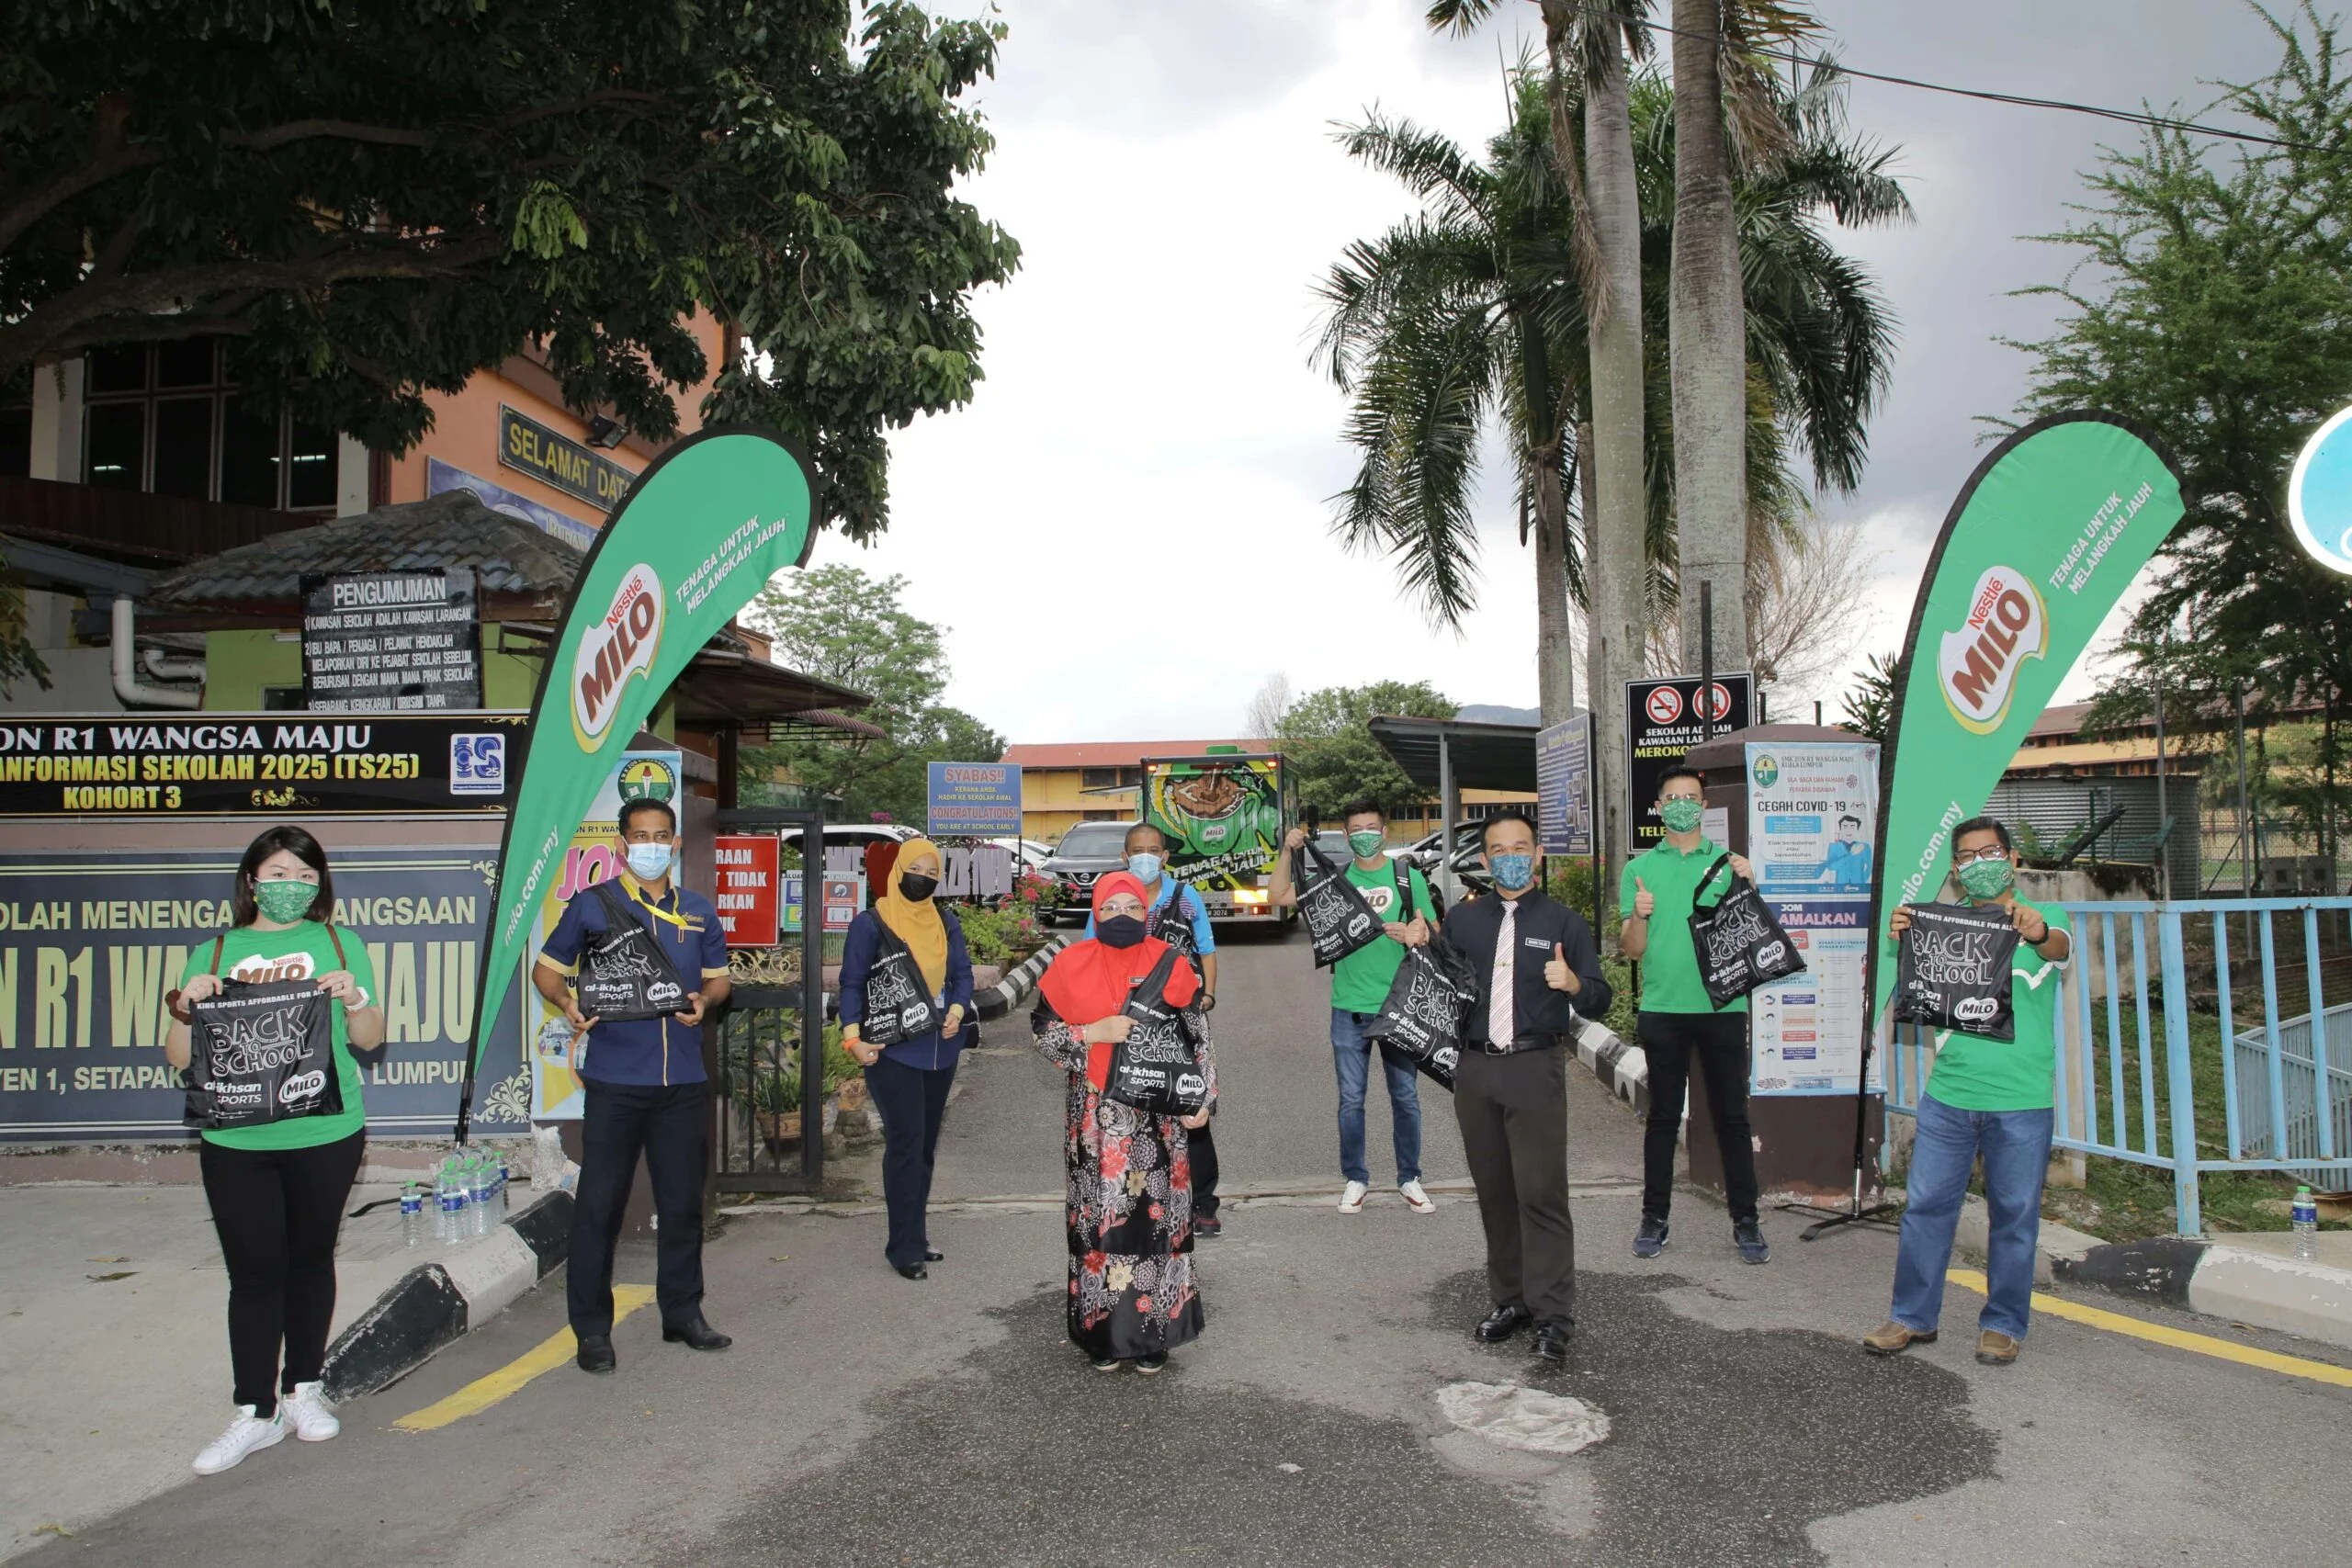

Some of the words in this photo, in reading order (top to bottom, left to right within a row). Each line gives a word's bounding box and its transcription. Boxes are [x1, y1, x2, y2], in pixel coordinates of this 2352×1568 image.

[510, 423, 590, 488] SELAMAT
[598, 468, 631, 502] DAT
[2050, 537, 2089, 589] TENAGA
[2085, 491, 2122, 538] UNTUK
[2068, 514, 2128, 594] MELANGKAH
[2125, 481, 2153, 518] JAUH
[676, 554, 717, 603] TENAGA
[720, 514, 760, 555] UNTUK
[686, 546, 752, 615] MELANGKAH
[755, 518, 786, 548] JAUH
[334, 578, 446, 606] PENGUMUMAN
[344, 615, 372, 627] SEKOLAH
[376, 613, 401, 625] ADALAH
[403, 611, 435, 625] KAWASAN
[436, 608, 470, 623] LARANGAN
[325, 640, 341, 654] BAPA
[349, 638, 377, 652] PENJAGA
[384, 637, 413, 650] PELAWAT
[416, 634, 453, 649] HENDAKLAH
[1952, 589, 2030, 711] MILO
[312, 658, 355, 671] MELAPORKAN
[357, 657, 368, 670] DIRI
[371, 656, 380, 669] KE
[383, 654, 410, 668] PEJABAT
[413, 652, 441, 666] SEKOLAH
[443, 650, 471, 664] SEBELUM
[582, 592, 655, 723] MILO
[313, 675, 349, 689] BERURUSAN
[352, 673, 378, 687] DENGAN
[380, 672, 399, 684] MANA
[402, 671, 420, 683] MANA
[423, 670, 441, 682] PIHAK
[444, 668, 472, 681] SEKOLAH
[426, 694, 446, 707] TANPA
[54, 727, 95, 750] R1
[109, 726, 263, 750] WANGSA
[274, 725, 370, 752] MAJU
[1639, 736, 1683, 746] KAWASAN
[1646, 727, 1689, 737] SEKOLAH
[1692, 725, 1731, 734] ADLAH
[1634, 746, 1696, 758] MEROKO
[142, 755, 254, 780] SEKOLAH
[261, 753, 327, 780] 2025
[945, 768, 1005, 783] SYABAS!!
[63, 786, 161, 809] KOHORT
[165, 786, 181, 808] 3
[1758, 801, 1792, 812] CEGAH
[931, 807, 1018, 819] CONGRATULATIONS!!
[1205, 829, 1224, 837] MILO
[1172, 854, 1234, 878] TENAGA
[1177, 866, 1228, 884] ELANGKAH
[1230, 855, 1270, 874] JAUH
[505, 824, 559, 946] milo.com.my
[727, 872, 766, 886] TIDAK
[328, 897, 476, 926] ANGSAAN
[1779, 913, 1856, 925] AMALKAN
[1917, 911, 1941, 920] SPORTS
[1943, 916, 1985, 928] AFFORDABLE
[1351, 917, 1367, 932] MILO
[1760, 945, 1782, 963] MILO
[1911, 926, 1992, 962] BACK
[1916, 955, 1993, 985] CHOOL
[1930, 954, 1947, 965] TO
[1723, 967, 1748, 985] SPORTS
[35, 946, 93, 1048] R1
[248, 994, 295, 1006] AFFORDABLE
[905, 1007, 926, 1022] MILO
[1962, 1004, 1993, 1014] MILO
[205, 1004, 307, 1054] BACK
[1388, 1011, 1430, 1041] al-ikhsan
[1394, 1024, 1426, 1049] SPORTS
[212, 1036, 313, 1077] SCHOOL
[240, 1041, 262, 1055] TO
[1128, 1043, 1193, 1064] SCHOOL
[0, 1067, 37, 1091] EN
[1119, 1066, 1166, 1078] al-ikhsan
[1130, 1077, 1166, 1088] SPORTS
[286, 1077, 321, 1095] MILO
